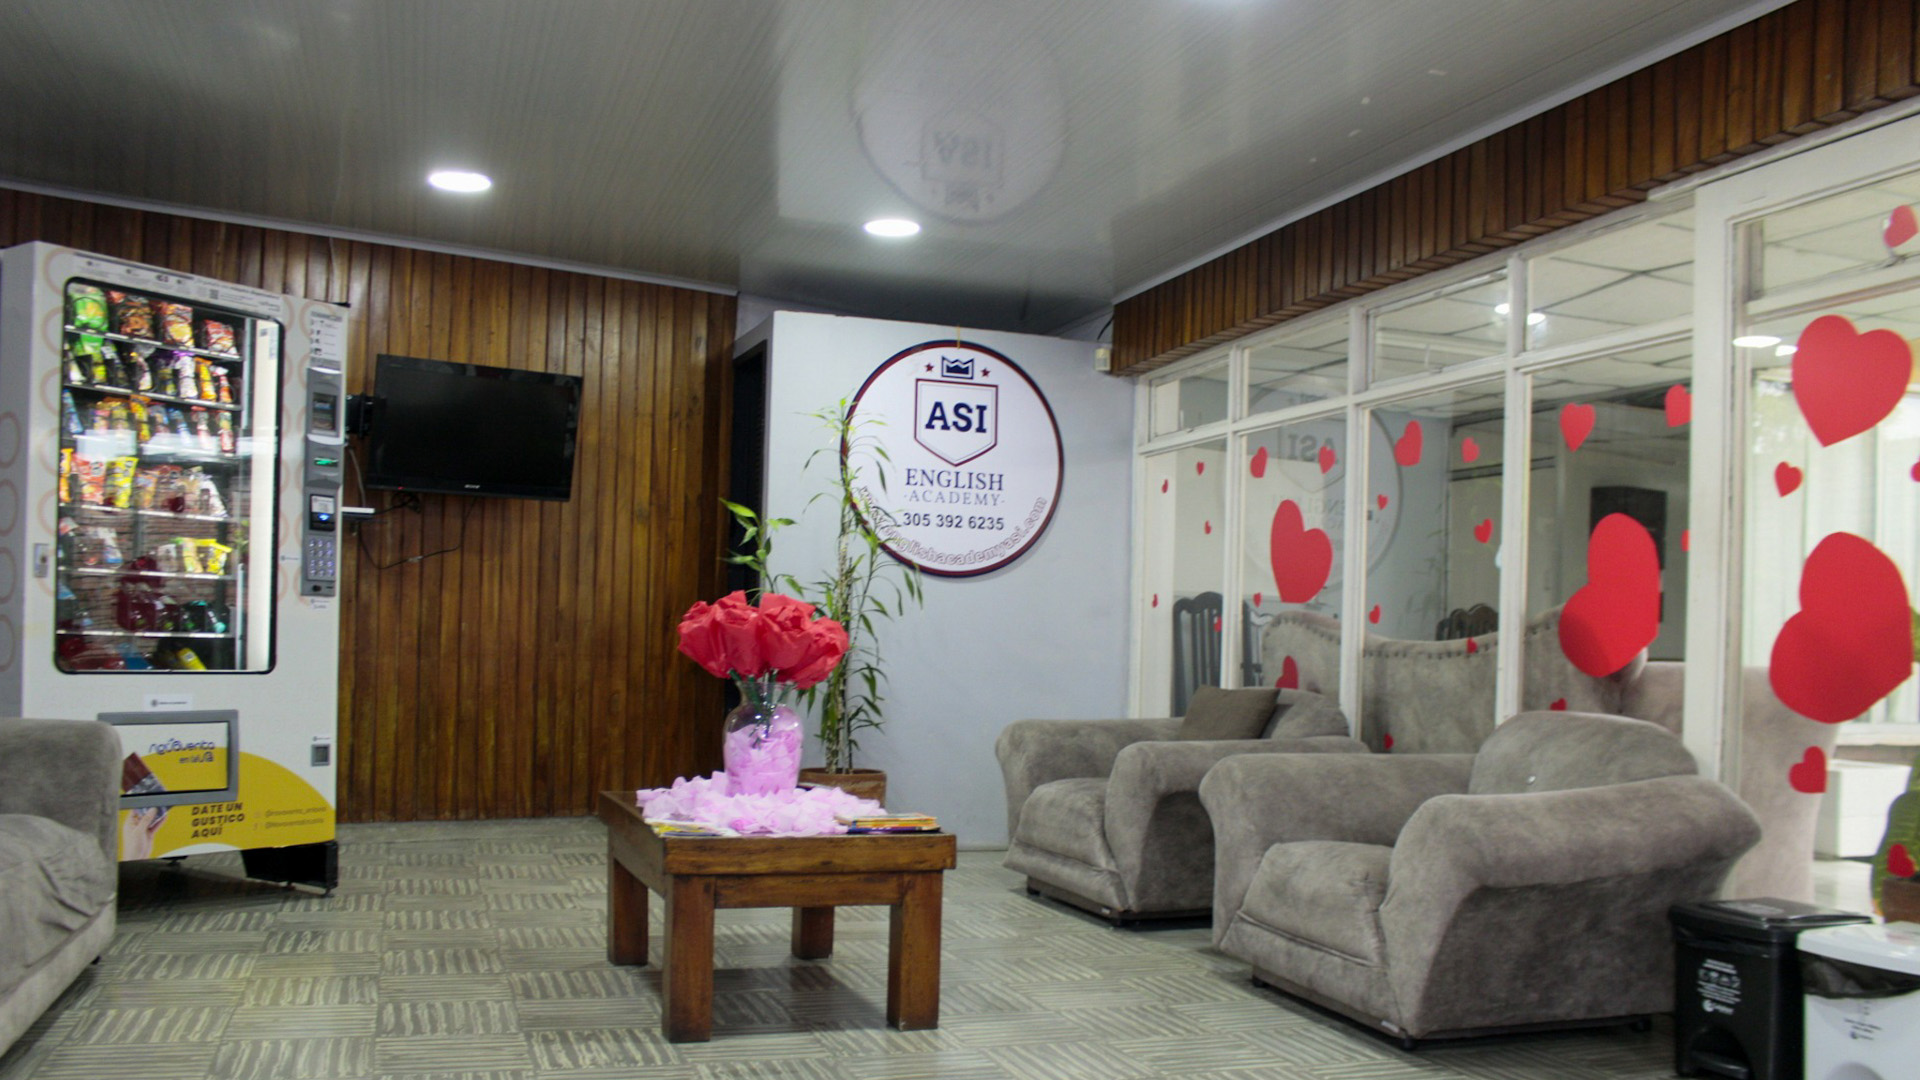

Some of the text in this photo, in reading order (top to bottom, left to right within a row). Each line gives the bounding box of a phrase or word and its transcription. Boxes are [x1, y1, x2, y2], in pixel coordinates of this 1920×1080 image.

[925, 401, 988, 434] ASI
[904, 467, 1005, 491] ENGLISH
[858, 485, 1048, 566] wwwenglishacademyasi.com
[902, 512, 1005, 531] 305 392 6235
[191, 802, 244, 816] DATE UN
[191, 813, 246, 828] GUSTICO
[191, 823, 223, 839] AQUÍ
